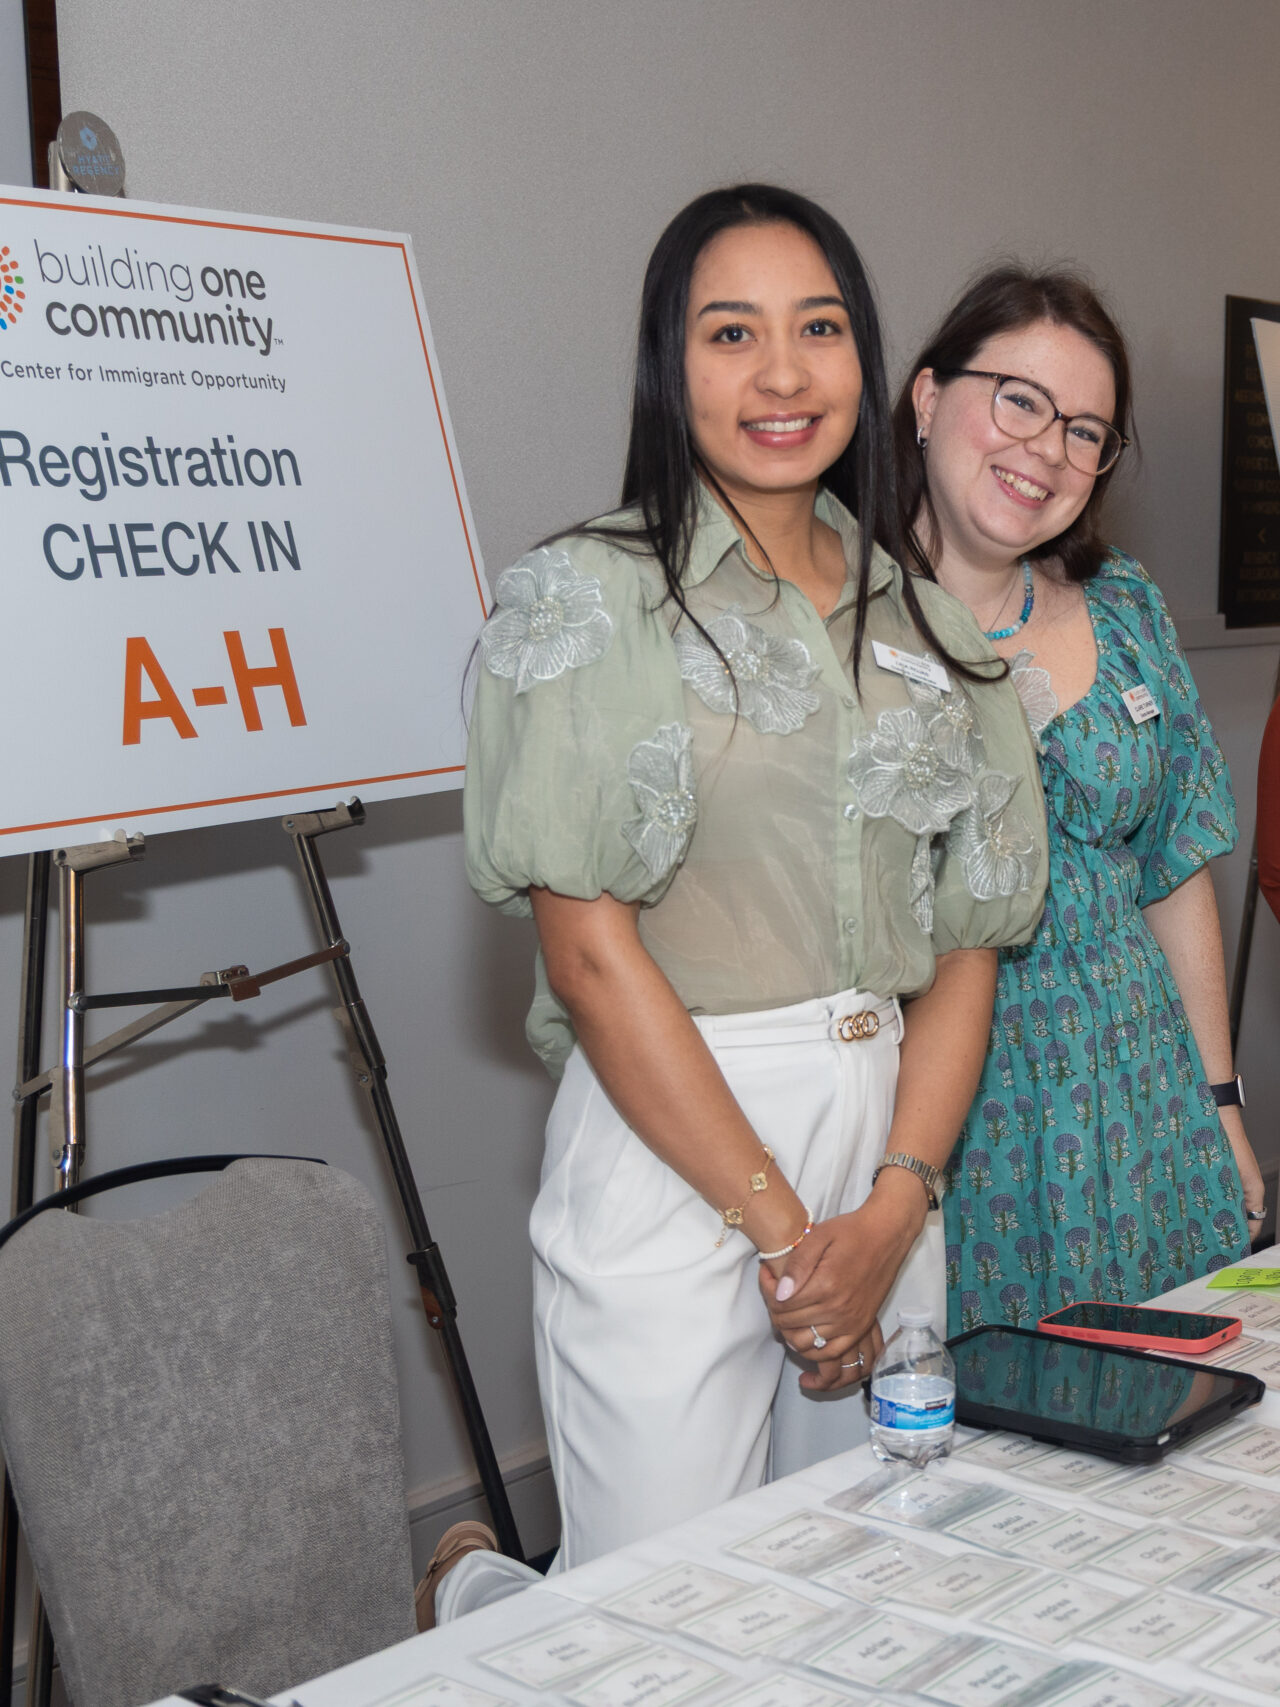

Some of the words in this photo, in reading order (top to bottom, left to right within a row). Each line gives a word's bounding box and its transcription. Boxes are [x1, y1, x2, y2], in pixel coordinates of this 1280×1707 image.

[34, 239, 194, 302] building
[201, 267, 266, 300] one
[1, 361, 61, 380] Center
[68, 364, 93, 381] for
[100, 366, 186, 387] Immigrant
[191, 371, 286, 393] Opportunity
[0, 430, 302, 501] Registration
[42, 521, 241, 581] CHECK
[247, 521, 302, 572] IN
[122, 627, 307, 746] A-H
